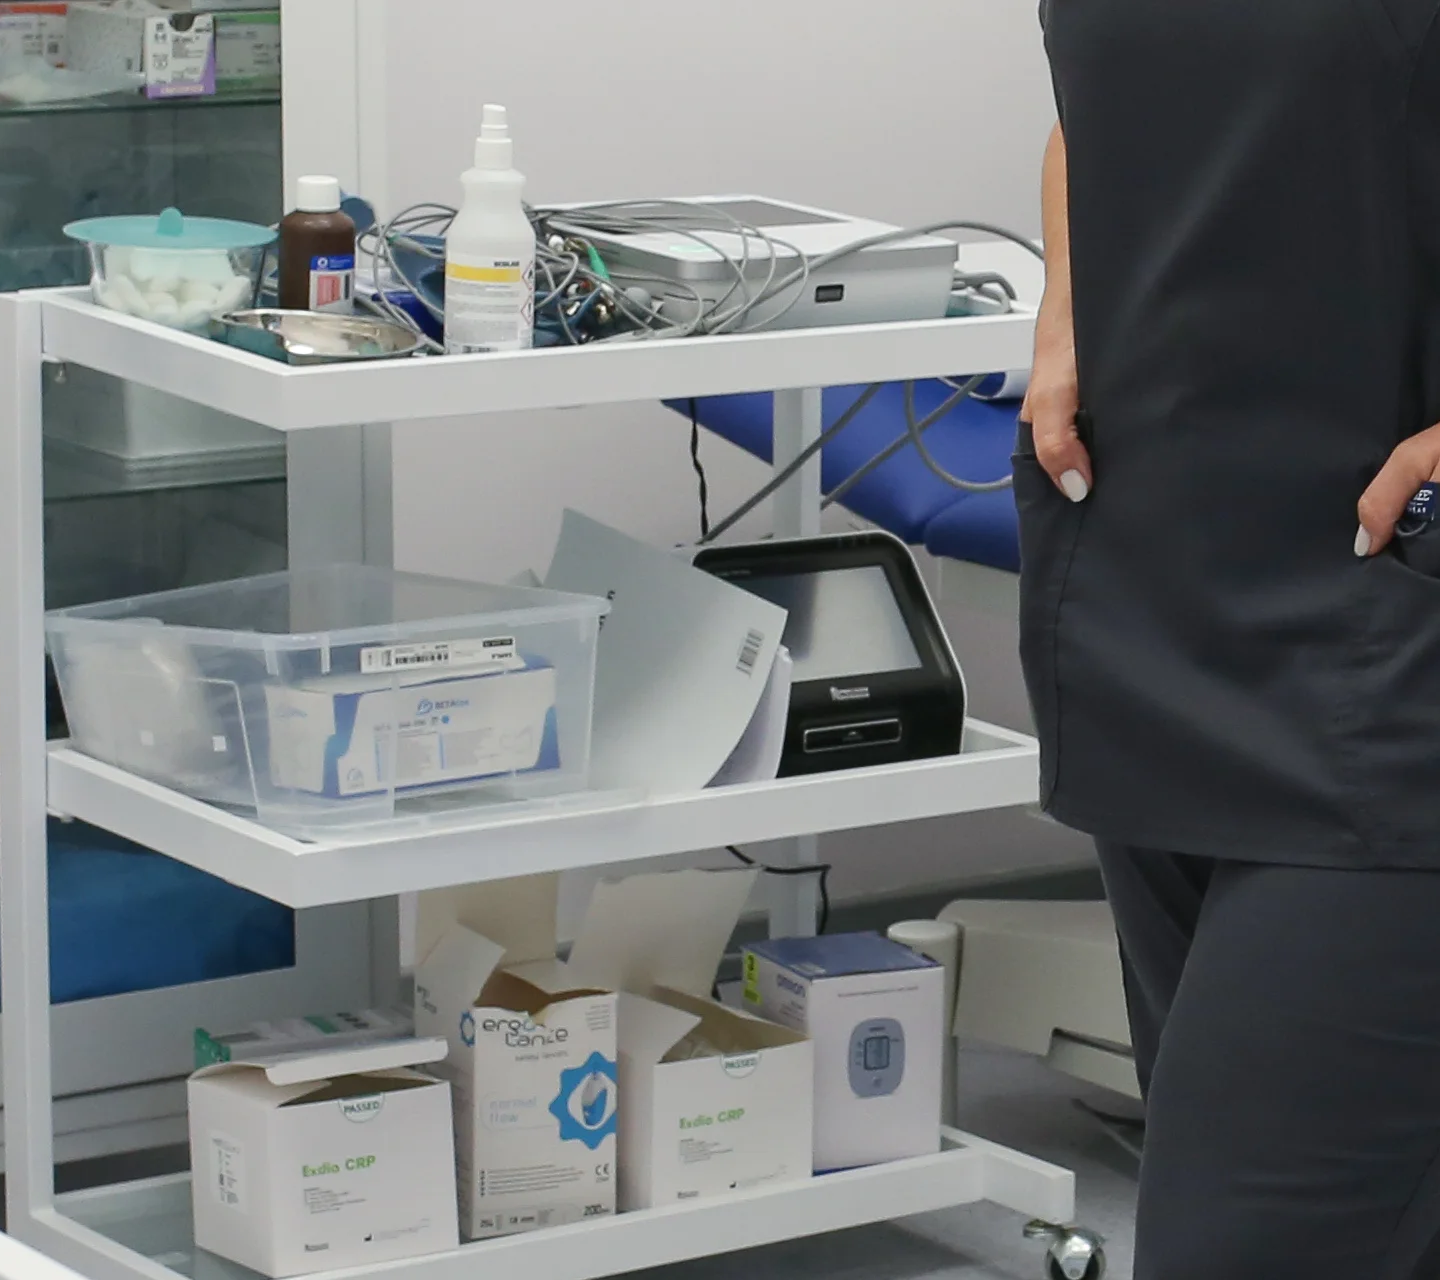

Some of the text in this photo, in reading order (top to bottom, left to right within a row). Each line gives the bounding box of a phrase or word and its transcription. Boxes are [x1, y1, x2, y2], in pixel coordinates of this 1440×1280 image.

[724, 1056, 758, 1070] PASSED
[343, 1100, 380, 1114] PASSED
[679, 1108, 746, 1130] Exdia CRP
[302, 1155, 376, 1178] Exdia CRP
